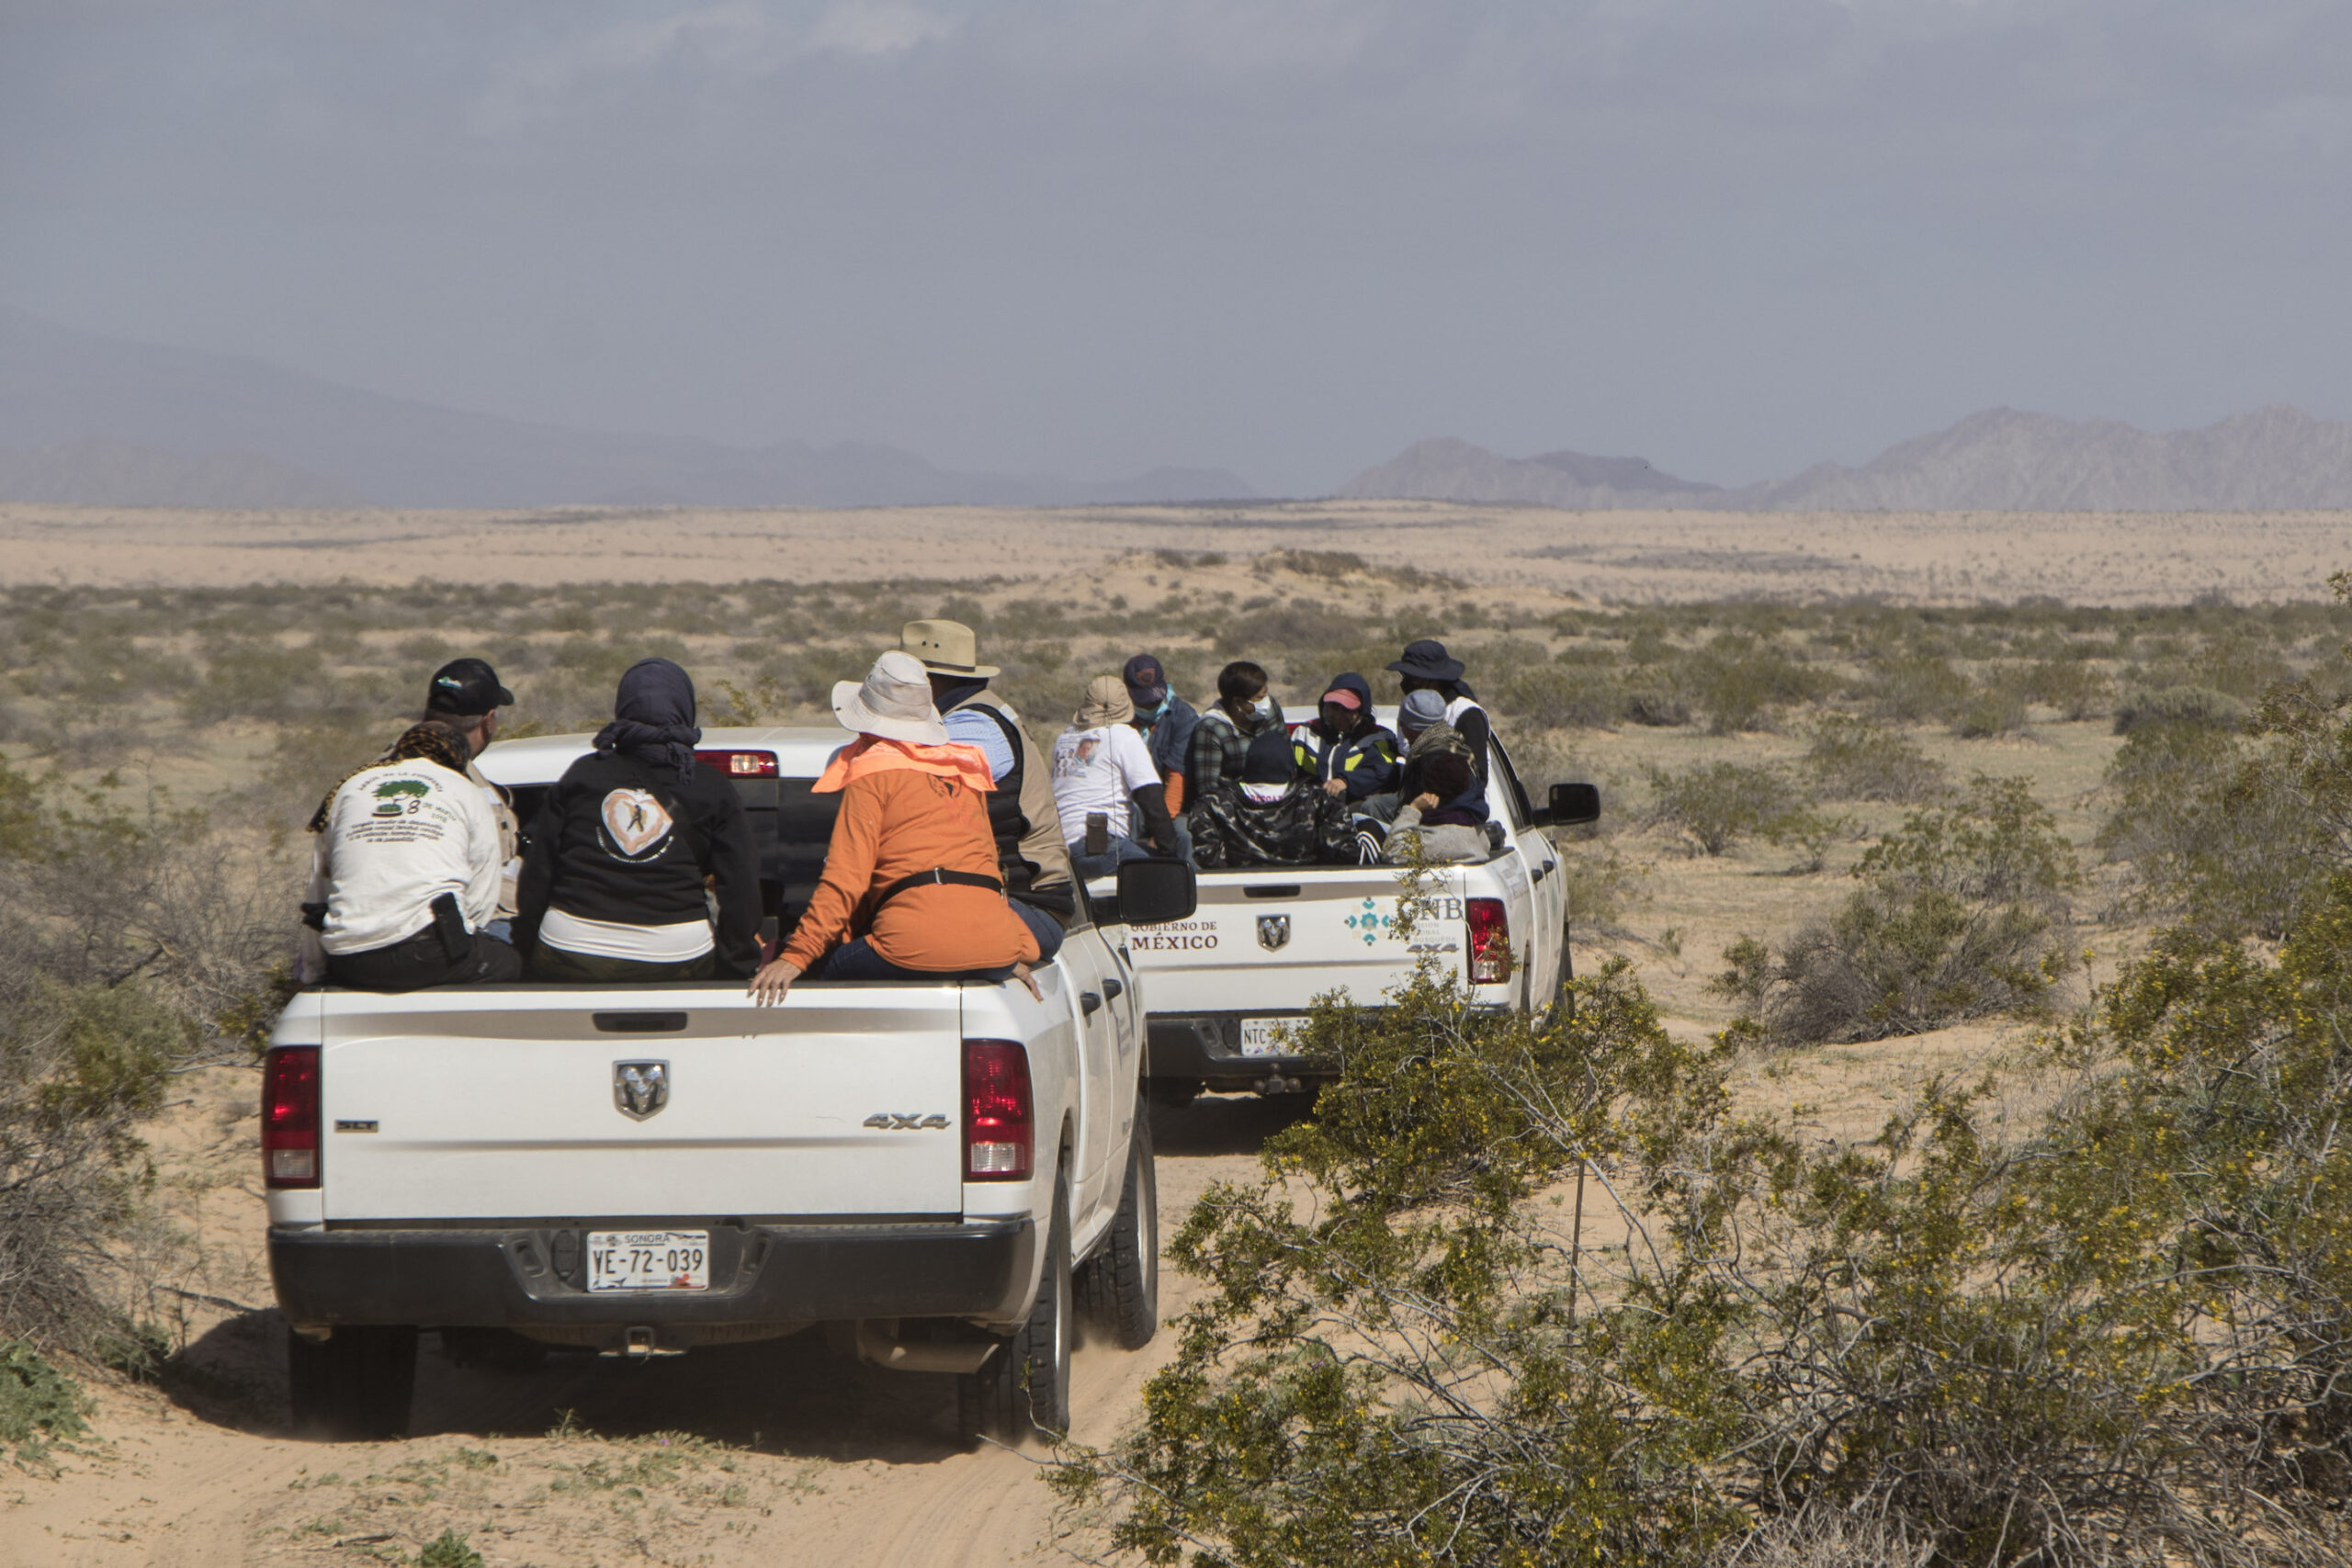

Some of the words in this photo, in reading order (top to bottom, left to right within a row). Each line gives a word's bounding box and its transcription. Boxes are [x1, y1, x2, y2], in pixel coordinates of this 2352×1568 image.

[407, 799, 421, 814] 8
[1201, 921, 1217, 931] DE
[1131, 932, 1218, 950] MÉXICO
[1407, 942, 1460, 953] 4X4
[863, 1113, 952, 1130] 4X4
[625, 1234, 671, 1244] SONORA
